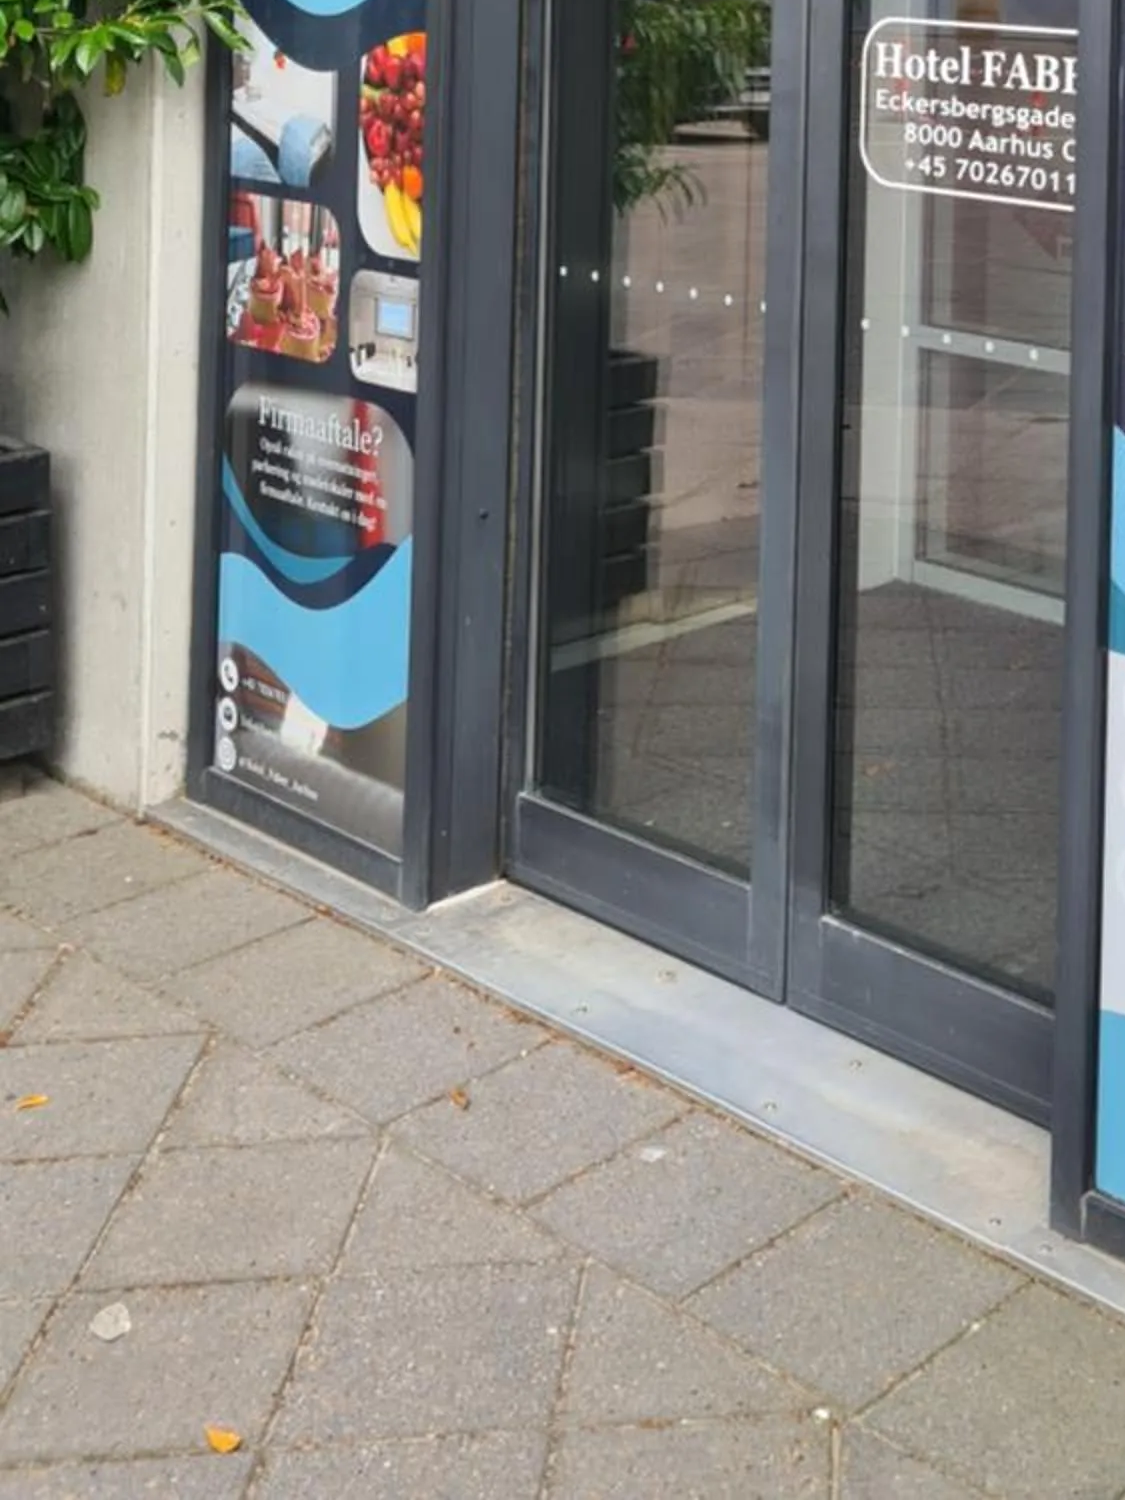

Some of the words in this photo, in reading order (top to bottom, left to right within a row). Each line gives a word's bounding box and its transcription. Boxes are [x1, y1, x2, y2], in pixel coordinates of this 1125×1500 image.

[875, 41, 971, 85] Hotel
[875, 89, 1076, 130] Eckersbergsgade
[904, 122, 962, 148] 8000
[968, 130, 1053, 160] Aarhus
[1062, 139, 1076, 162] C
[904, 155, 946, 178] +45
[955, 159, 1076, 195] 70267011
[258, 395, 383, 456] Firmaaftale?
